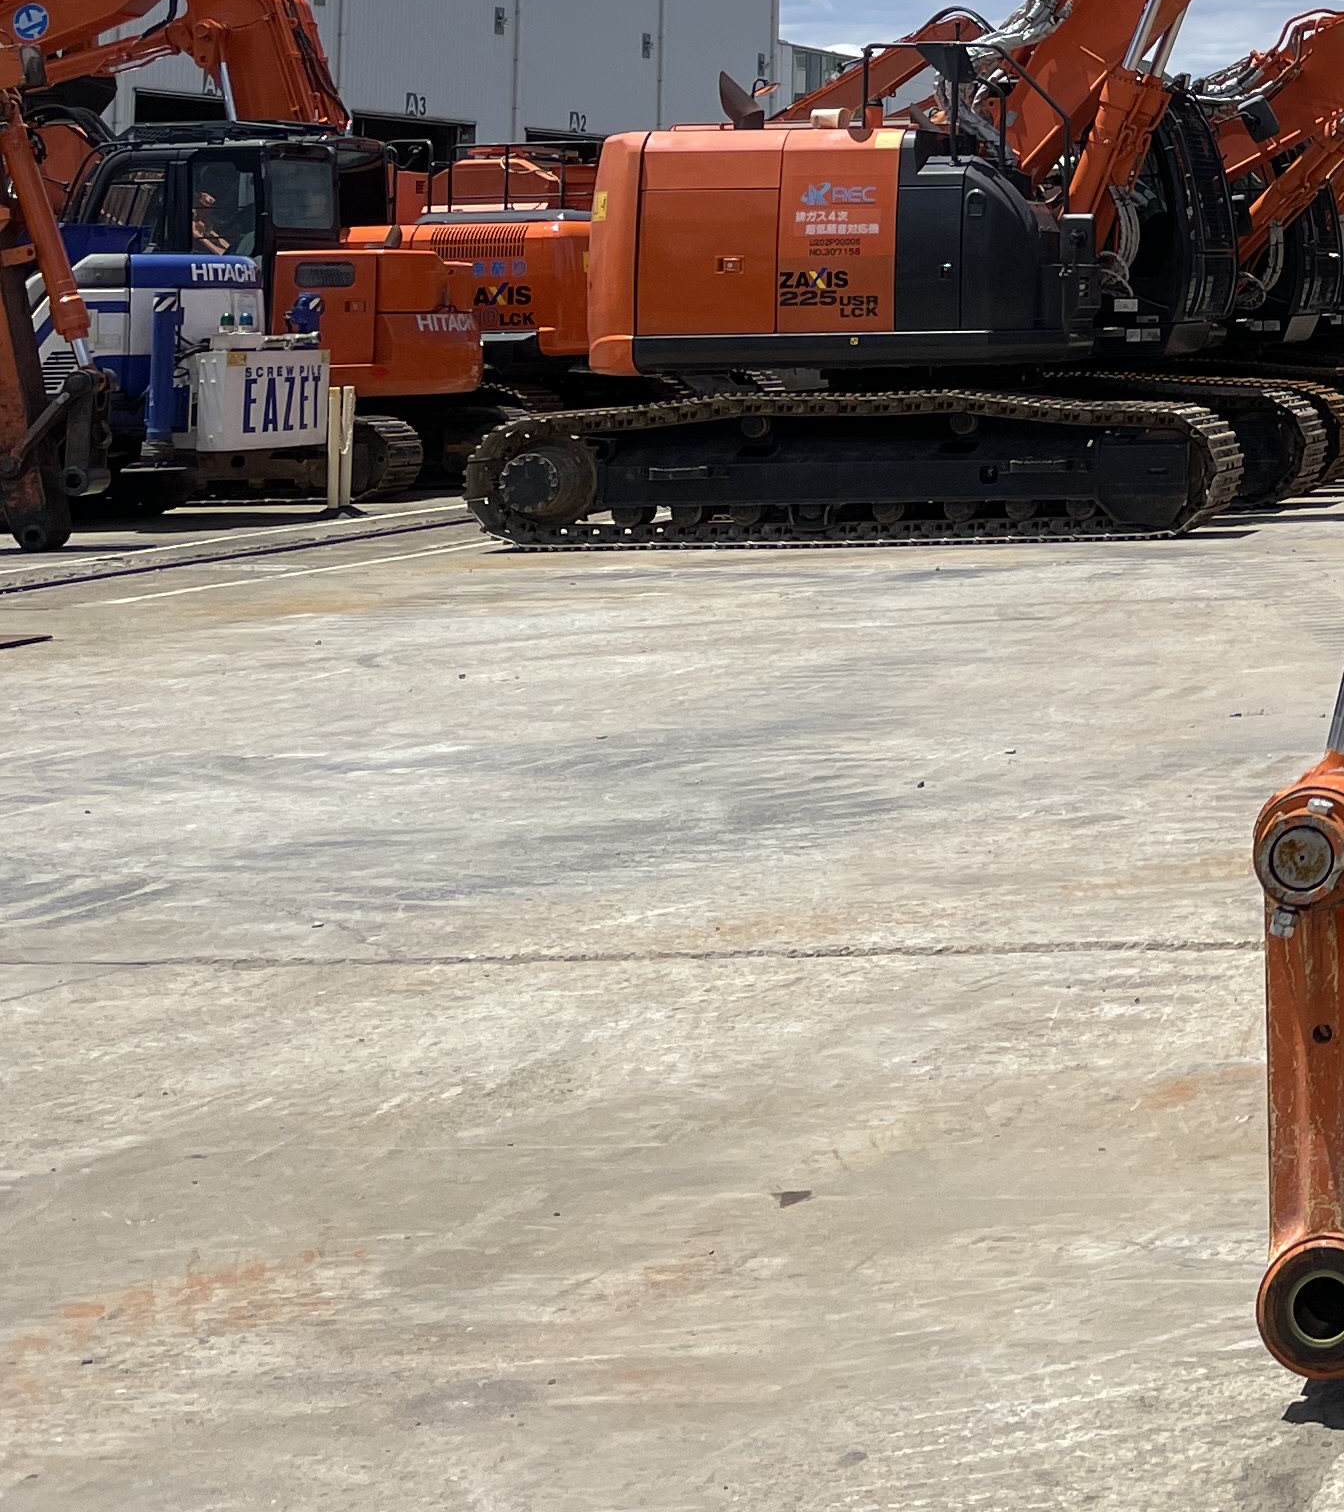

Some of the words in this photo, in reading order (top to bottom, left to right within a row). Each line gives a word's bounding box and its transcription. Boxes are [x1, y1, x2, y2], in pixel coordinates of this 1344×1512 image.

[406, 92, 426, 117] A3
[568, 111, 587, 133] A2
[779, 267, 849, 289] ZAXIS
[473, 282, 532, 306] AXIS
[779, 290, 838, 306] 225
[840, 295, 879, 306] USR
[500, 311, 535, 326] LCK
[840, 307, 879, 318] LCK
[245, 366, 294, 378] SCREW
[300, 365, 322, 377] PILE
[243, 375, 321, 434] EAZET
